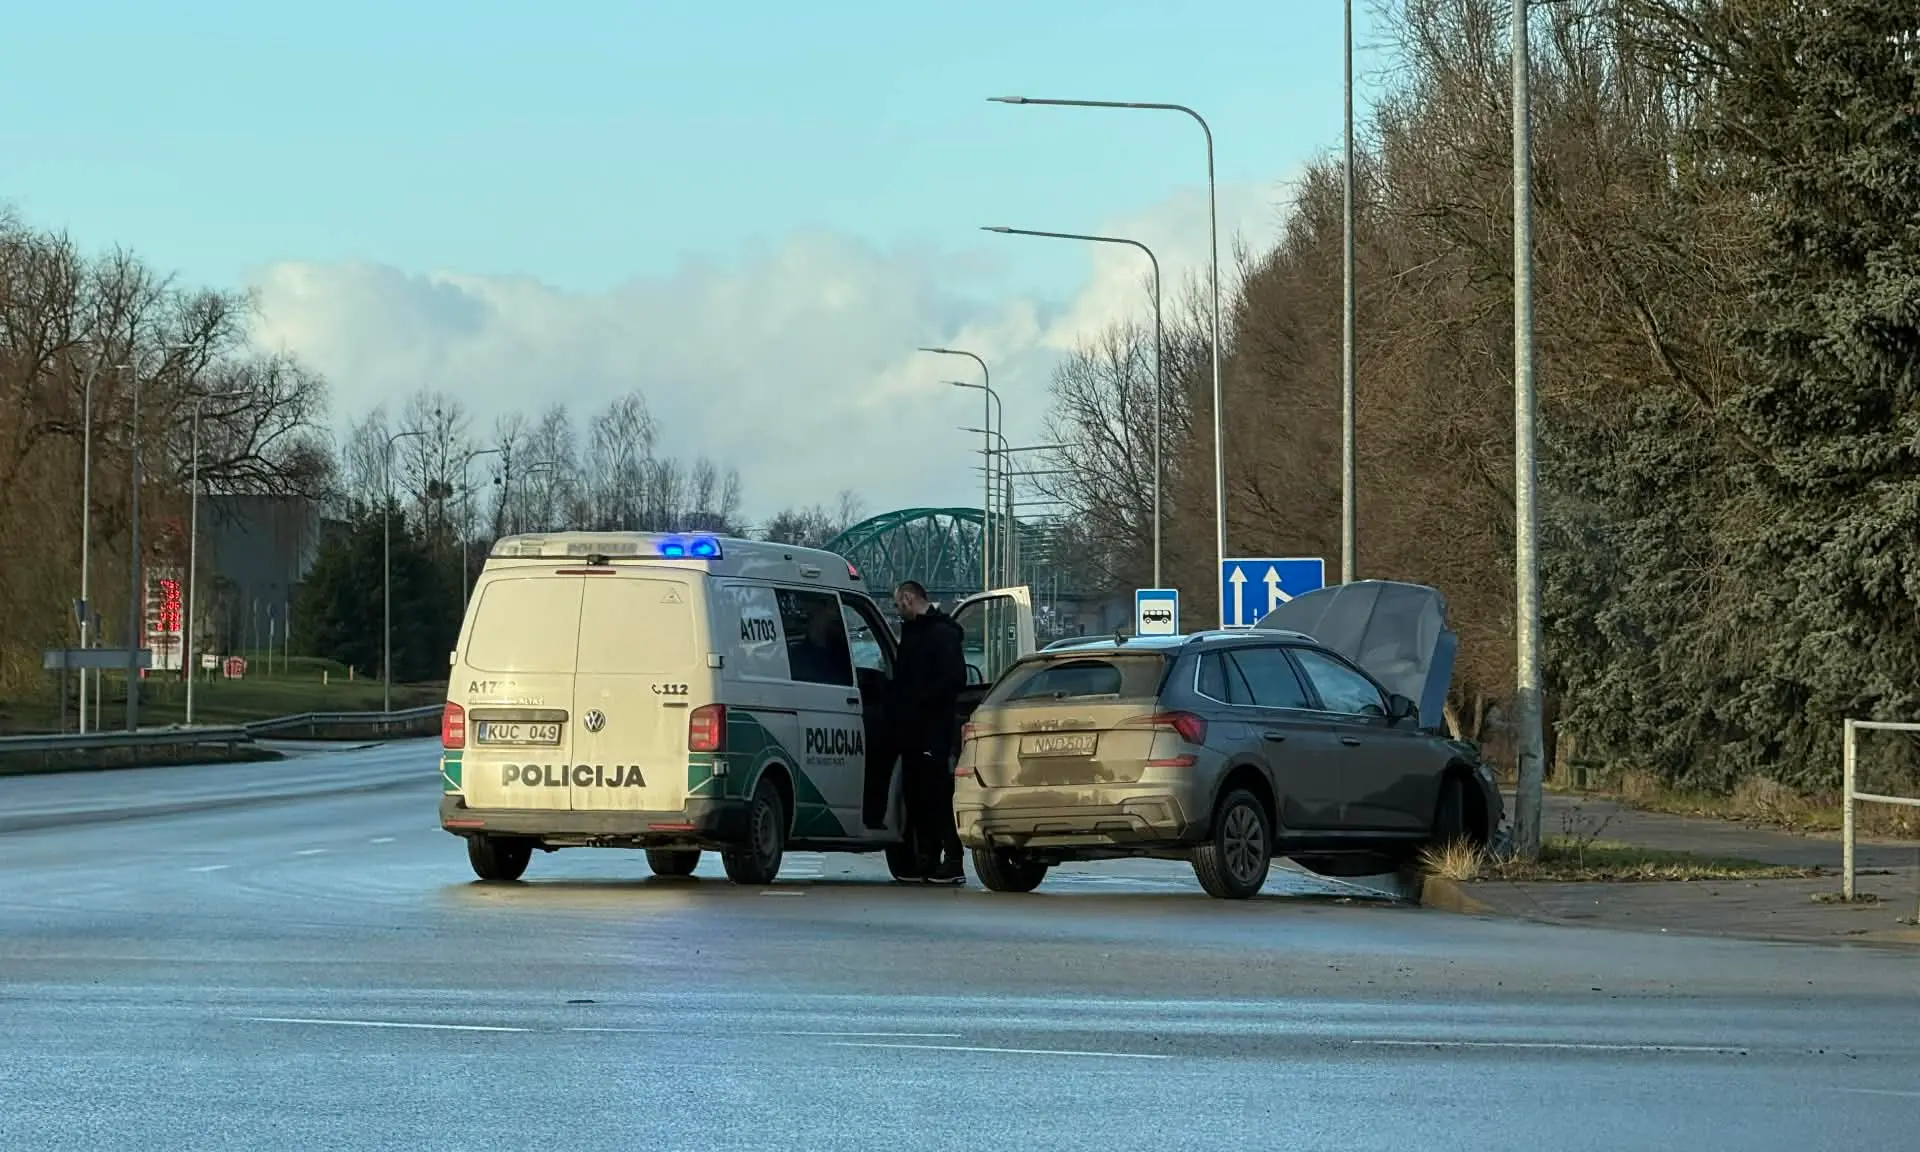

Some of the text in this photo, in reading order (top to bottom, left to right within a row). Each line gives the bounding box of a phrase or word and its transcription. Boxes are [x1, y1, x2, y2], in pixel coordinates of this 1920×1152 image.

[741, 618, 777, 641] A1703
[662, 684, 688, 695] 112
[487, 724, 557, 740] KUC 049
[806, 728, 864, 756] POLICIJA
[502, 763, 647, 787] POLICIJA
